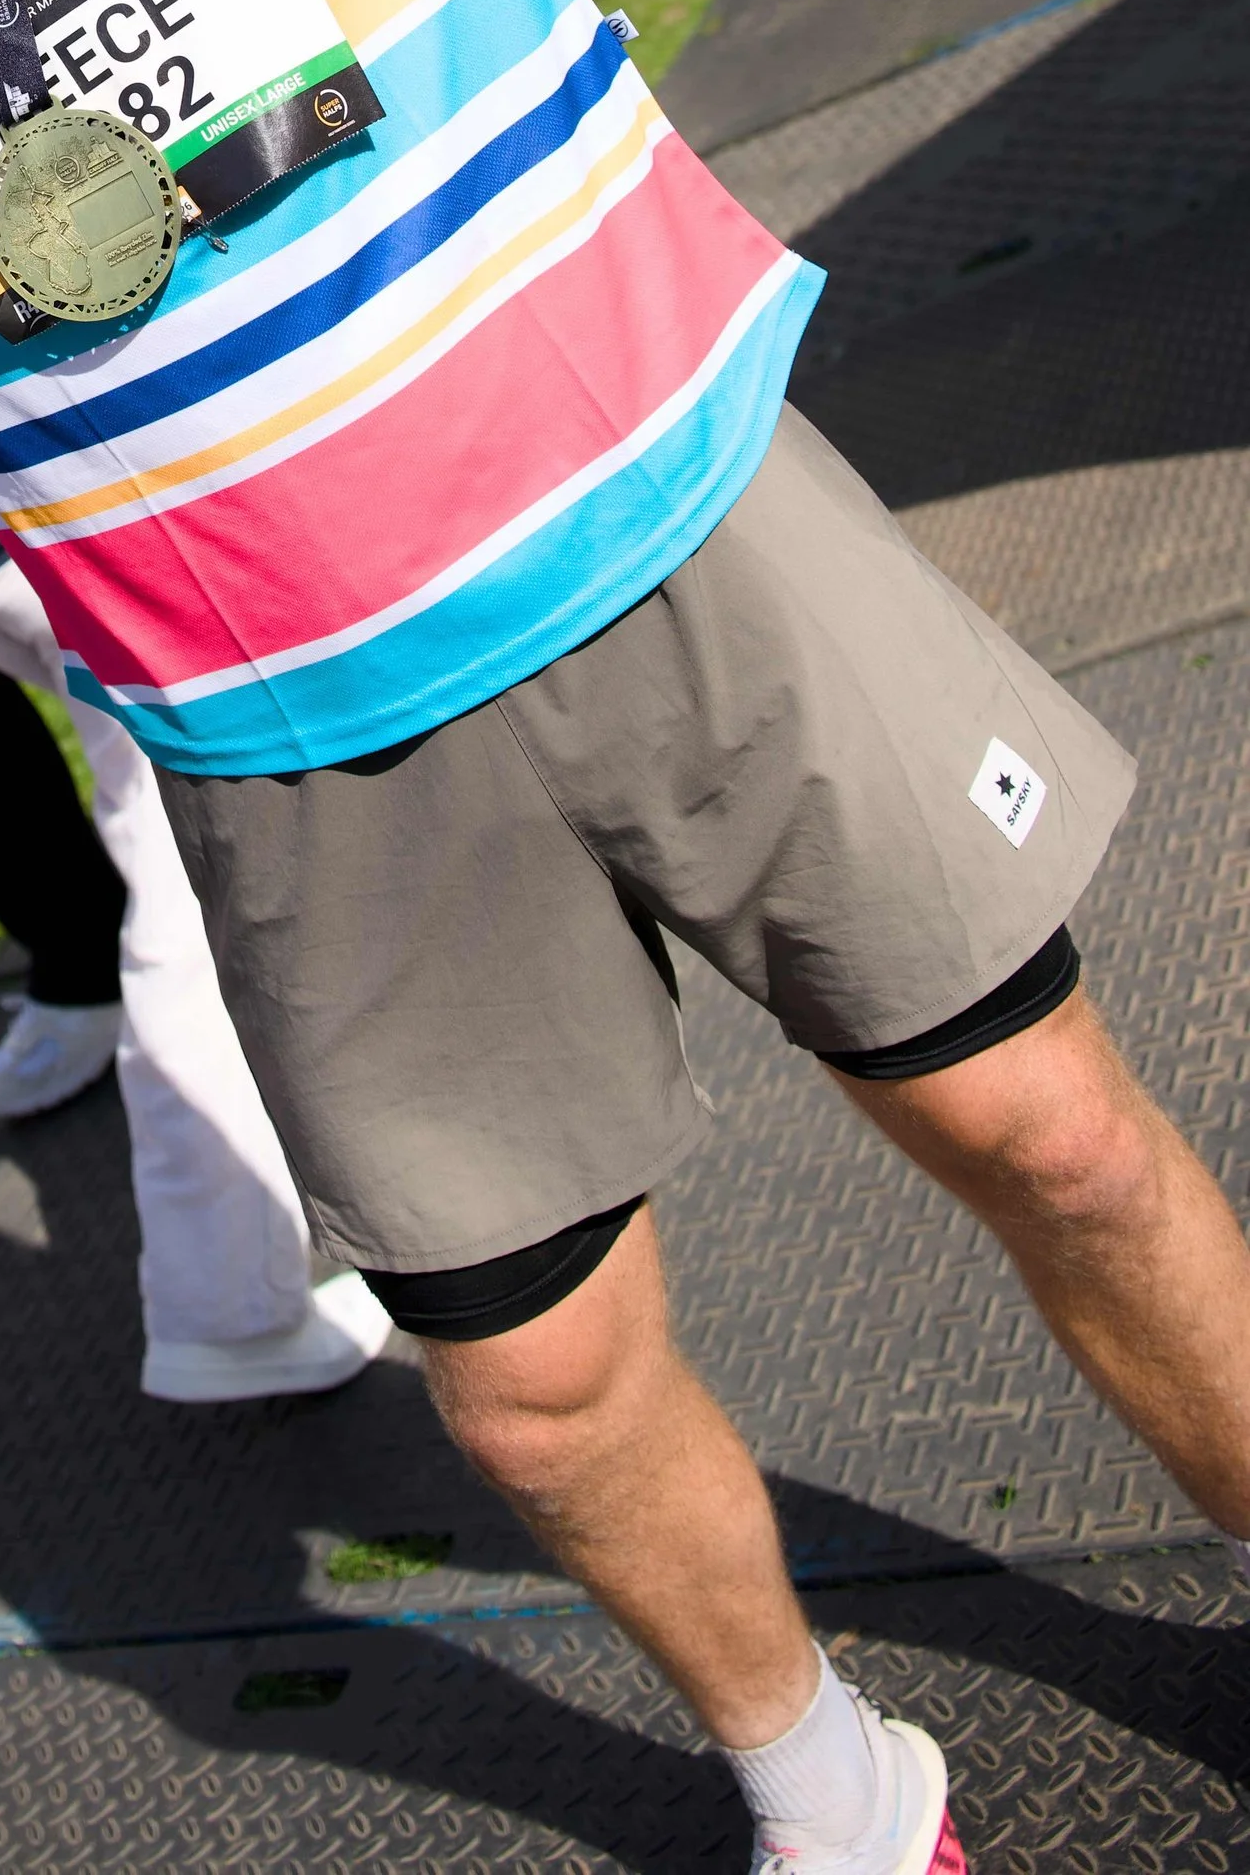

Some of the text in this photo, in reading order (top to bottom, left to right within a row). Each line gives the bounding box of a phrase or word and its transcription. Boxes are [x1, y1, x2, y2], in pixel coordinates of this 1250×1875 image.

[110, 55, 215, 142] 82
[200, 72, 307, 143] UNISEX LARGE
[320, 97, 340, 112] SUPER
[323, 103, 343, 118] HALFS
[1006, 775, 1032, 826] SAYSKY
